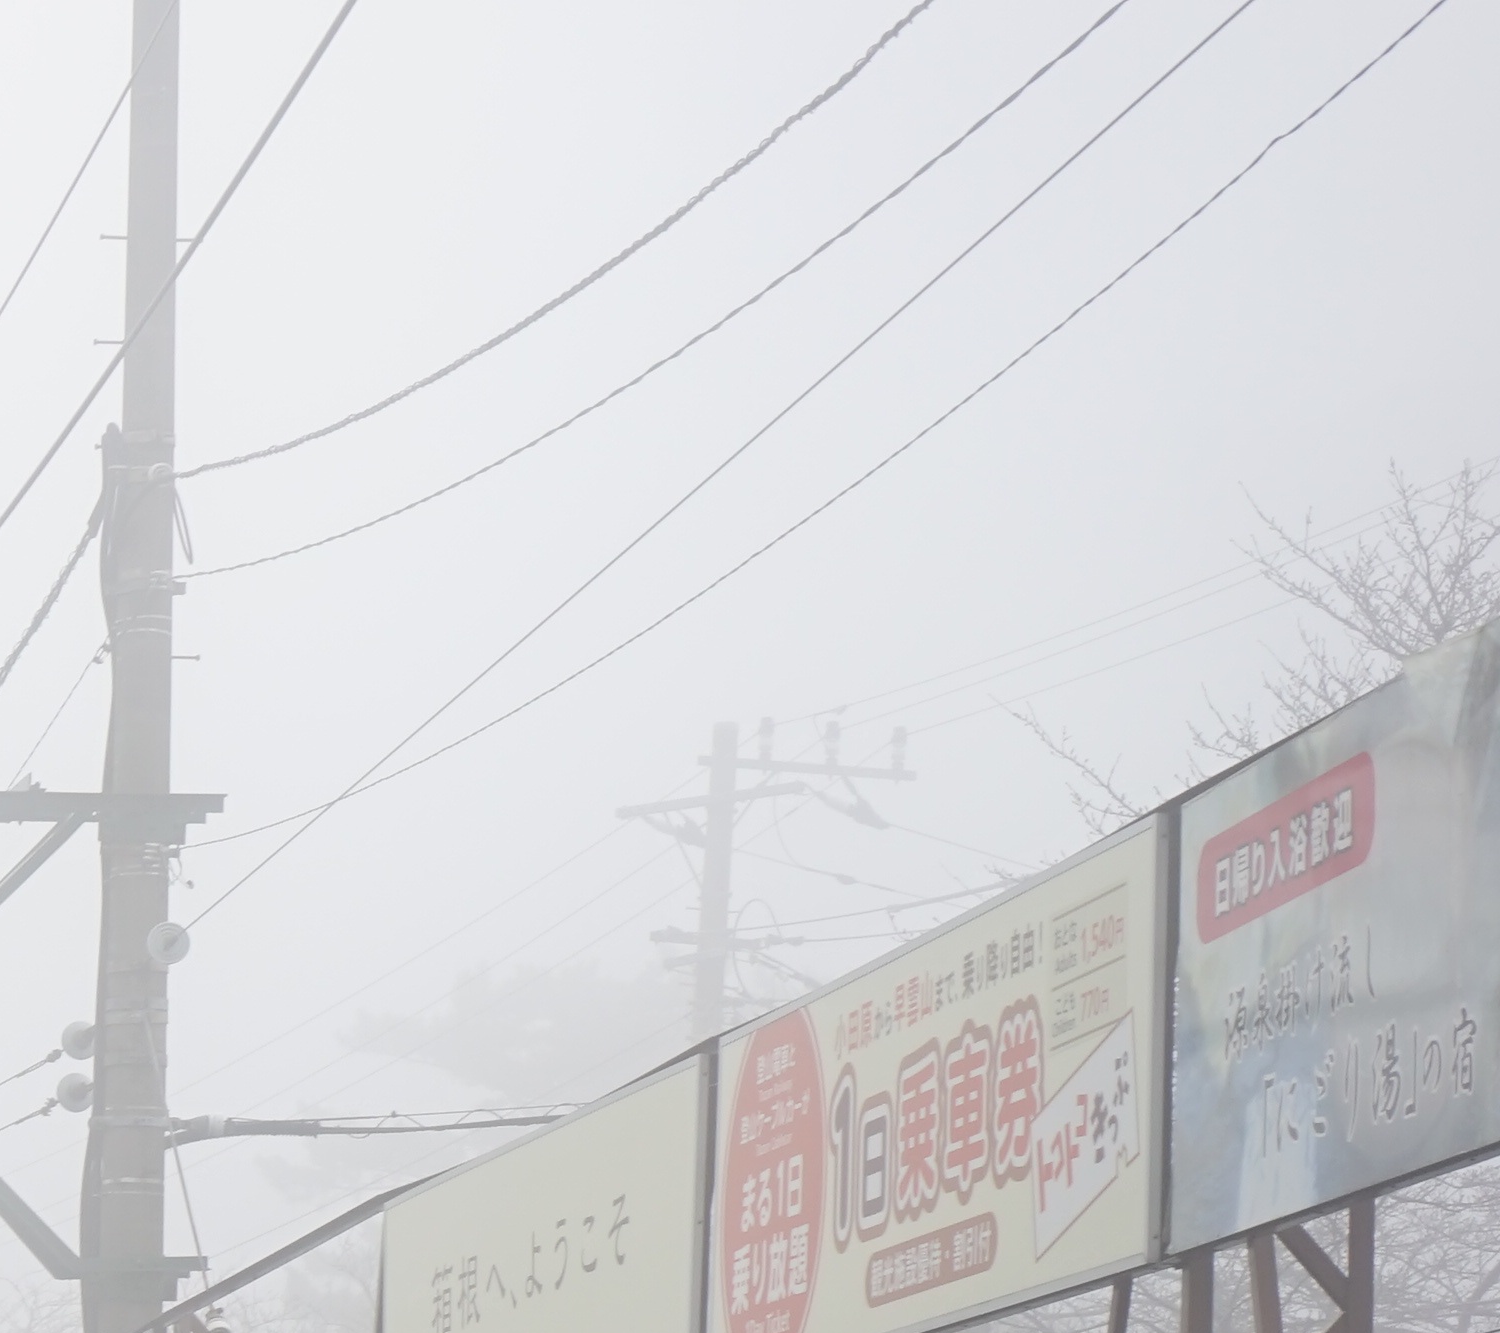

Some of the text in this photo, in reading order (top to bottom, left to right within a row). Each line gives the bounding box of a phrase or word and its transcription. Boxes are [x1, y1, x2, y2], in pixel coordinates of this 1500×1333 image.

[1215, 787, 1353, 918] 日帰り入浴歓迎
[1081, 915, 1124, 964] 1,540円
[1224, 925, 1376, 1062] 源泉掛け流し
[1081, 986, 1110, 1021] 770円
[830, 994, 1044, 1253] 1日乗車券
[1261, 1008, 1477, 1157] 「にごり湯」の宿
[740, 1154, 803, 1232] まる1日
[731, 1224, 809, 1314] 乗り放題
